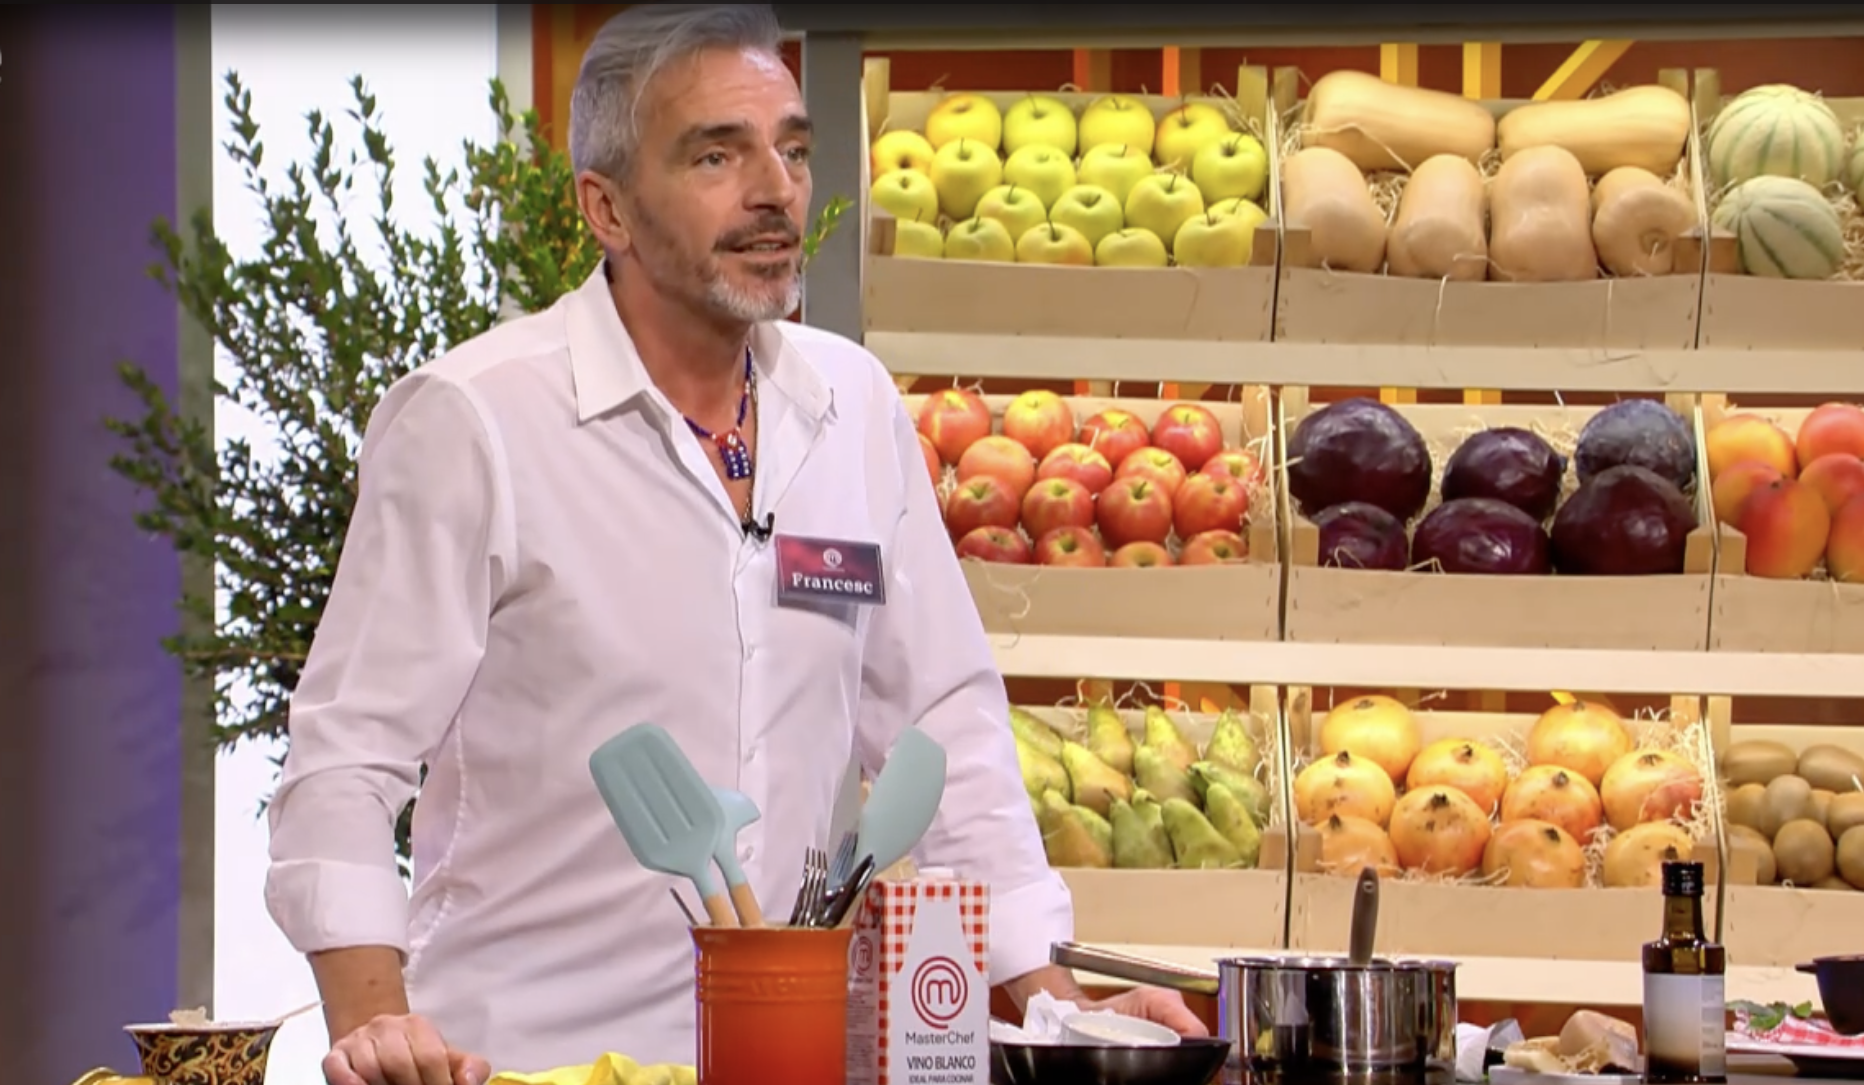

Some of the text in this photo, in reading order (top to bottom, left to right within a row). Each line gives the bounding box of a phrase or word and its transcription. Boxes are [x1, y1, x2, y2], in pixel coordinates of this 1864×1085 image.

[791, 572, 873, 595] Francesc
[905, 1031, 975, 1045] MasterChef
[906, 1055, 976, 1070] VINO BLANCO
